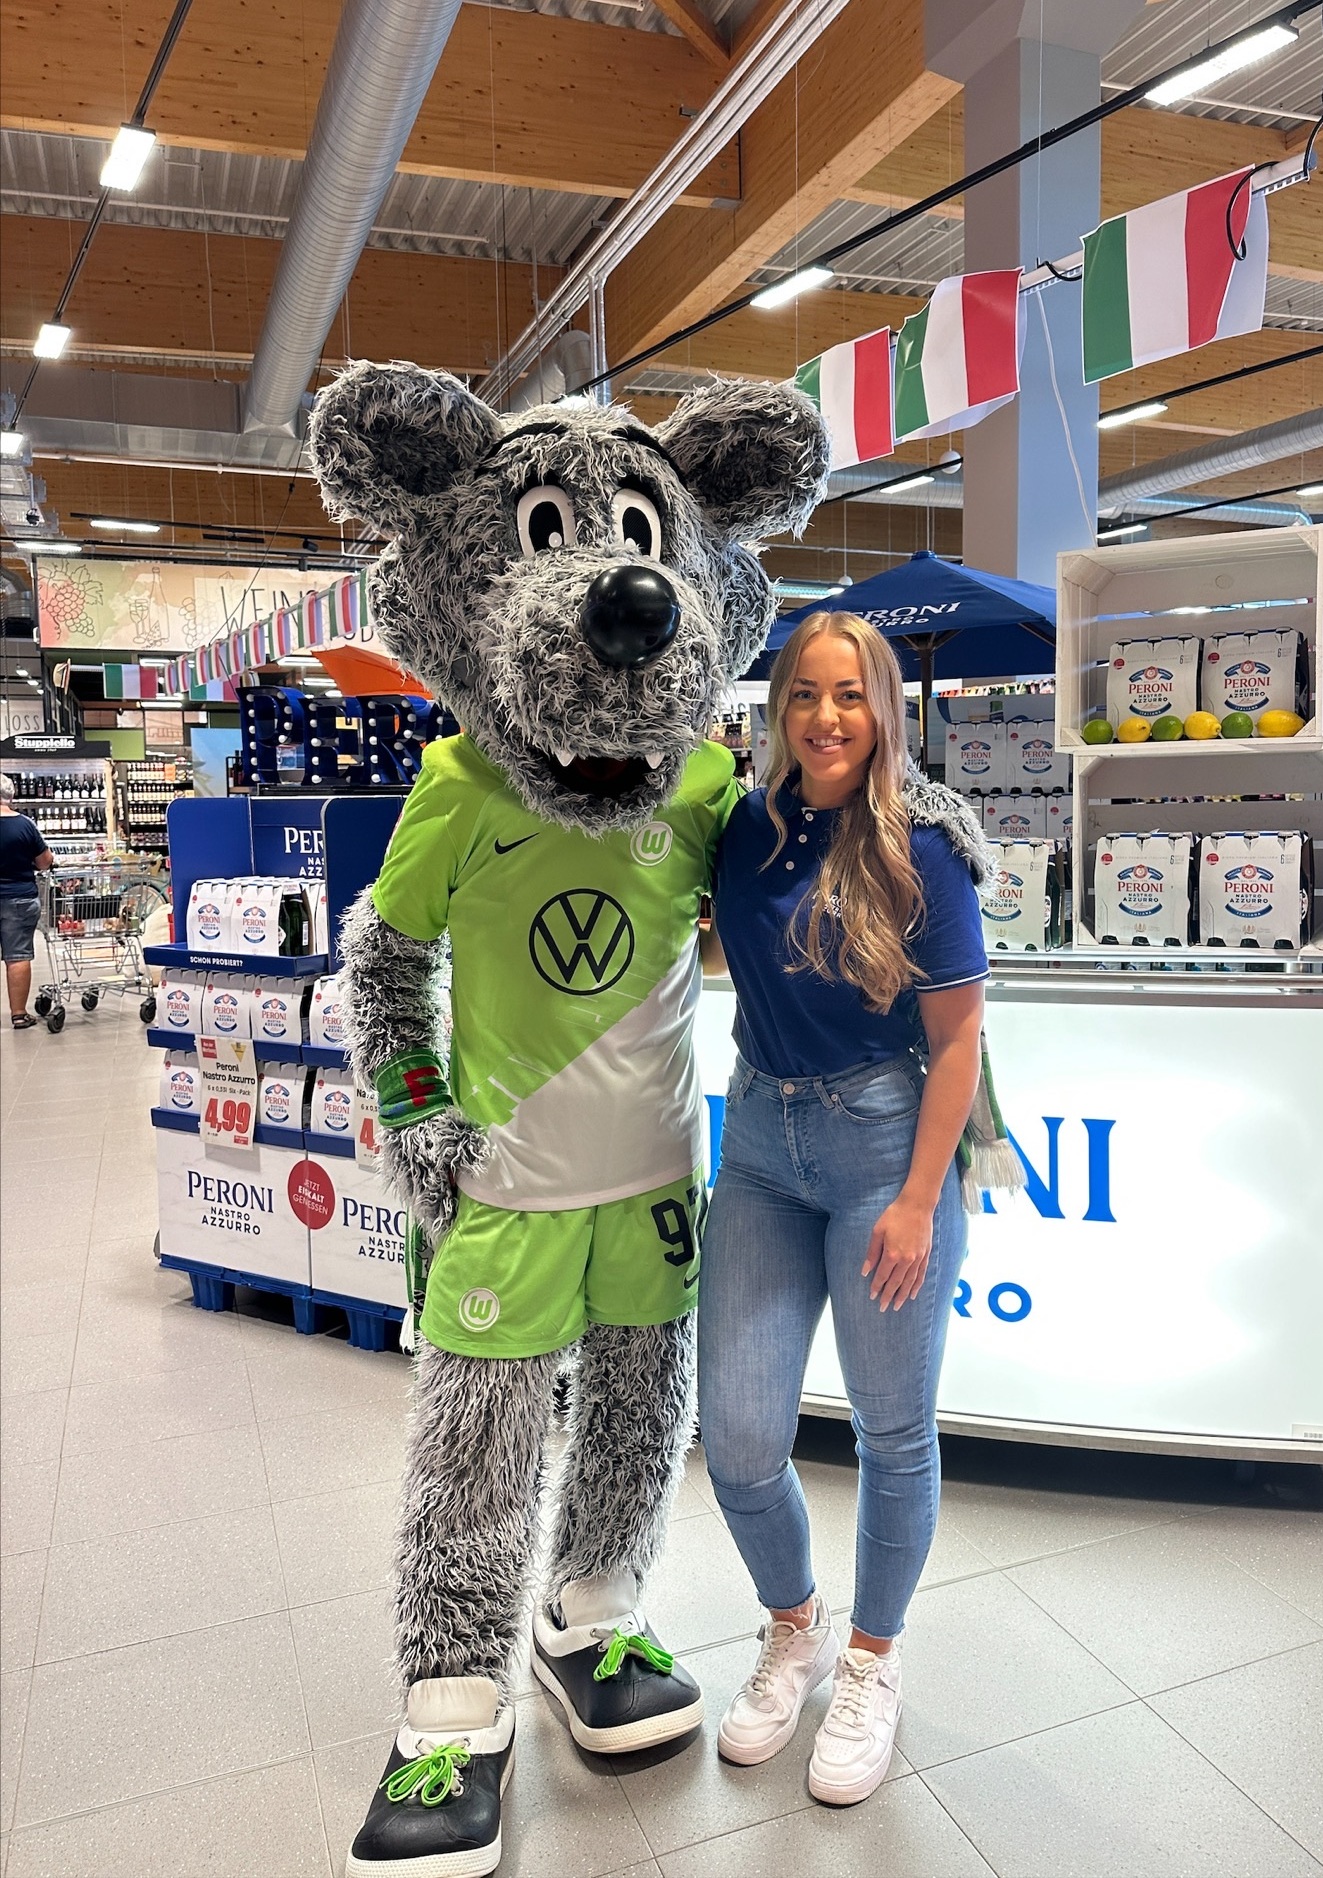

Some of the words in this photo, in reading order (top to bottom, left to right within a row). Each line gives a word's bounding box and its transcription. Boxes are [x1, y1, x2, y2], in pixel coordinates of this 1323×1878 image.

[1128, 682, 1173, 694] PERONI
[1224, 677, 1270, 689] PERONI
[1228, 691, 1265, 699] AZZURRO
[961, 751, 992, 759] PERONI
[1022, 750, 1053, 758] PERONI
[999, 826, 1030, 834] PERONI
[1117, 882, 1163, 893] PERONI
[1224, 882, 1274, 893] PERONI
[197, 915, 221, 924] PERONI
[242, 917, 266, 927] PERONI
[212, 957, 244, 967] PROBIERT?
[166, 1001, 190, 1011] PERONI
[213, 1005, 238, 1015] PERONI
[261, 1010, 287, 1020] PERONI
[215, 1062, 239, 1072] Peroni
[202, 1071, 227, 1082] Nastro
[227, 1074, 256, 1085] Azzurro
[170, 1082, 194, 1093] PERONI
[264, 1095, 290, 1106] PERONI
[324, 1102, 350, 1114] PERONI
[204, 1097, 252, 1134] 4,99
[187, 1170, 274, 1214] PERONI
[210, 1206, 250, 1221] NASTRO
[201, 1214, 261, 1235] AZZURRO
[358, 1245, 405, 1265] AZZUR
